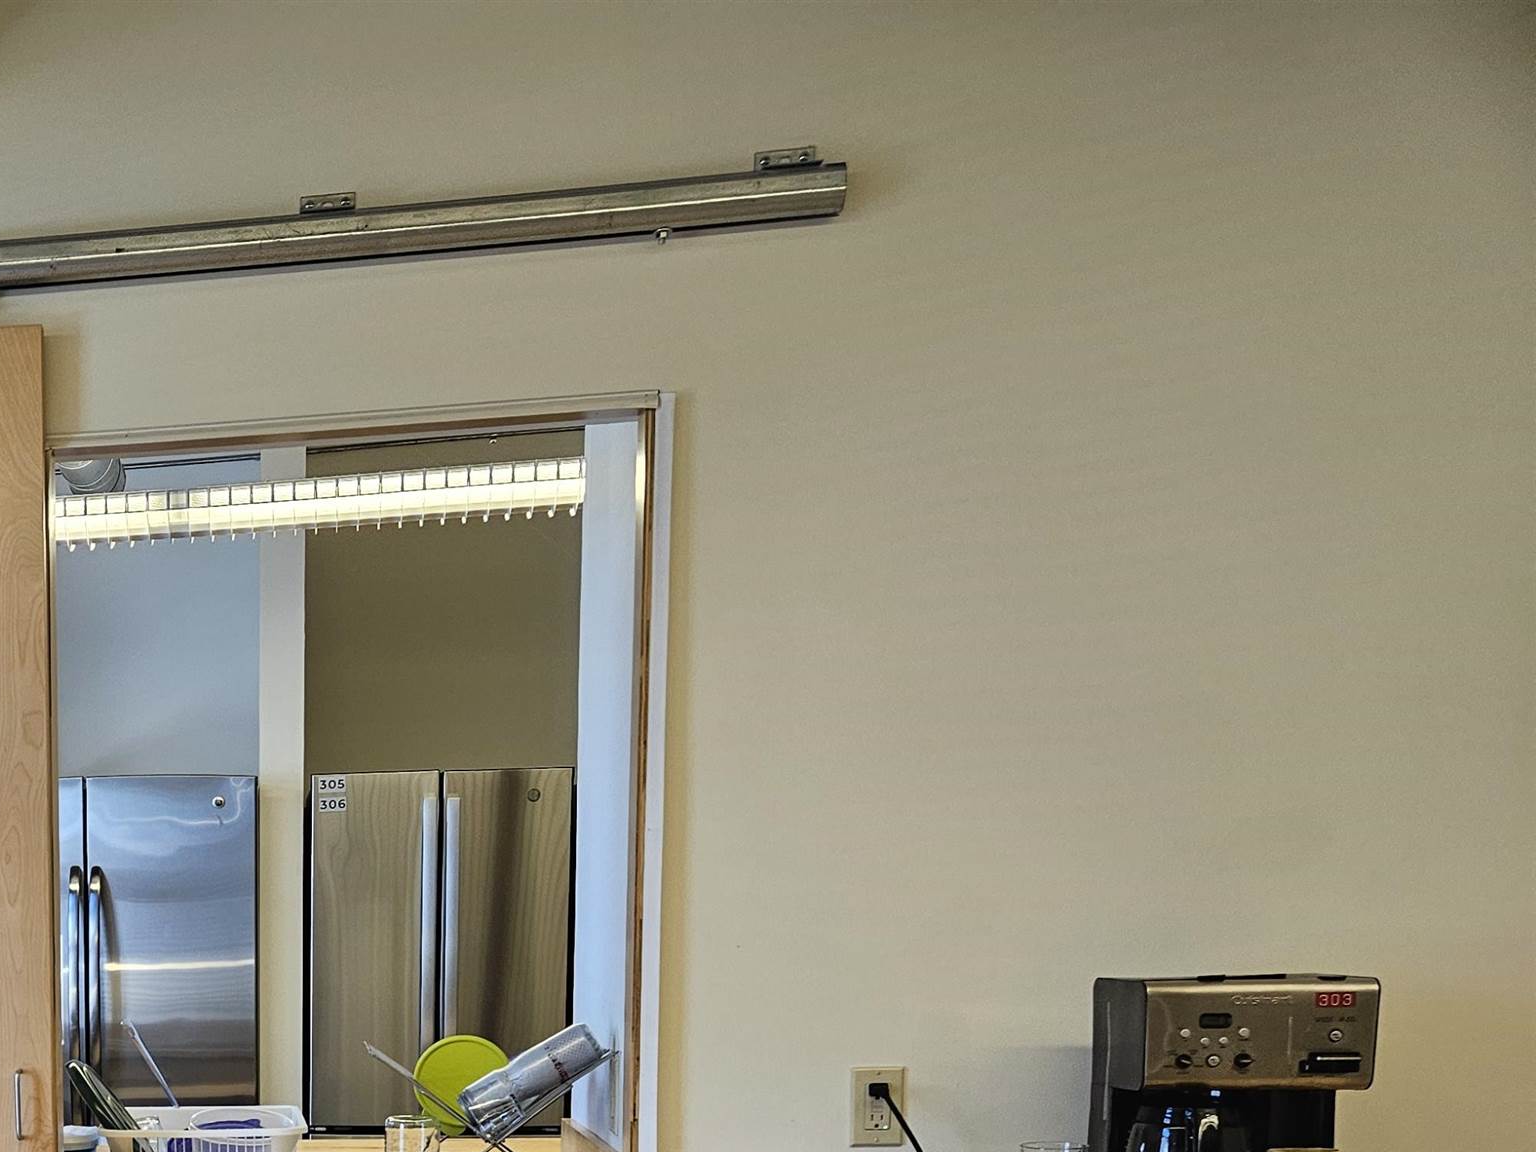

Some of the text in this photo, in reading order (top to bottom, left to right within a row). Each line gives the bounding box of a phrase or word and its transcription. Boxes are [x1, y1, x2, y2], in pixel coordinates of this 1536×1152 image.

[320, 779, 345, 790] 305
[320, 799, 346, 810] 306
[1318, 992, 1353, 1007] 303
